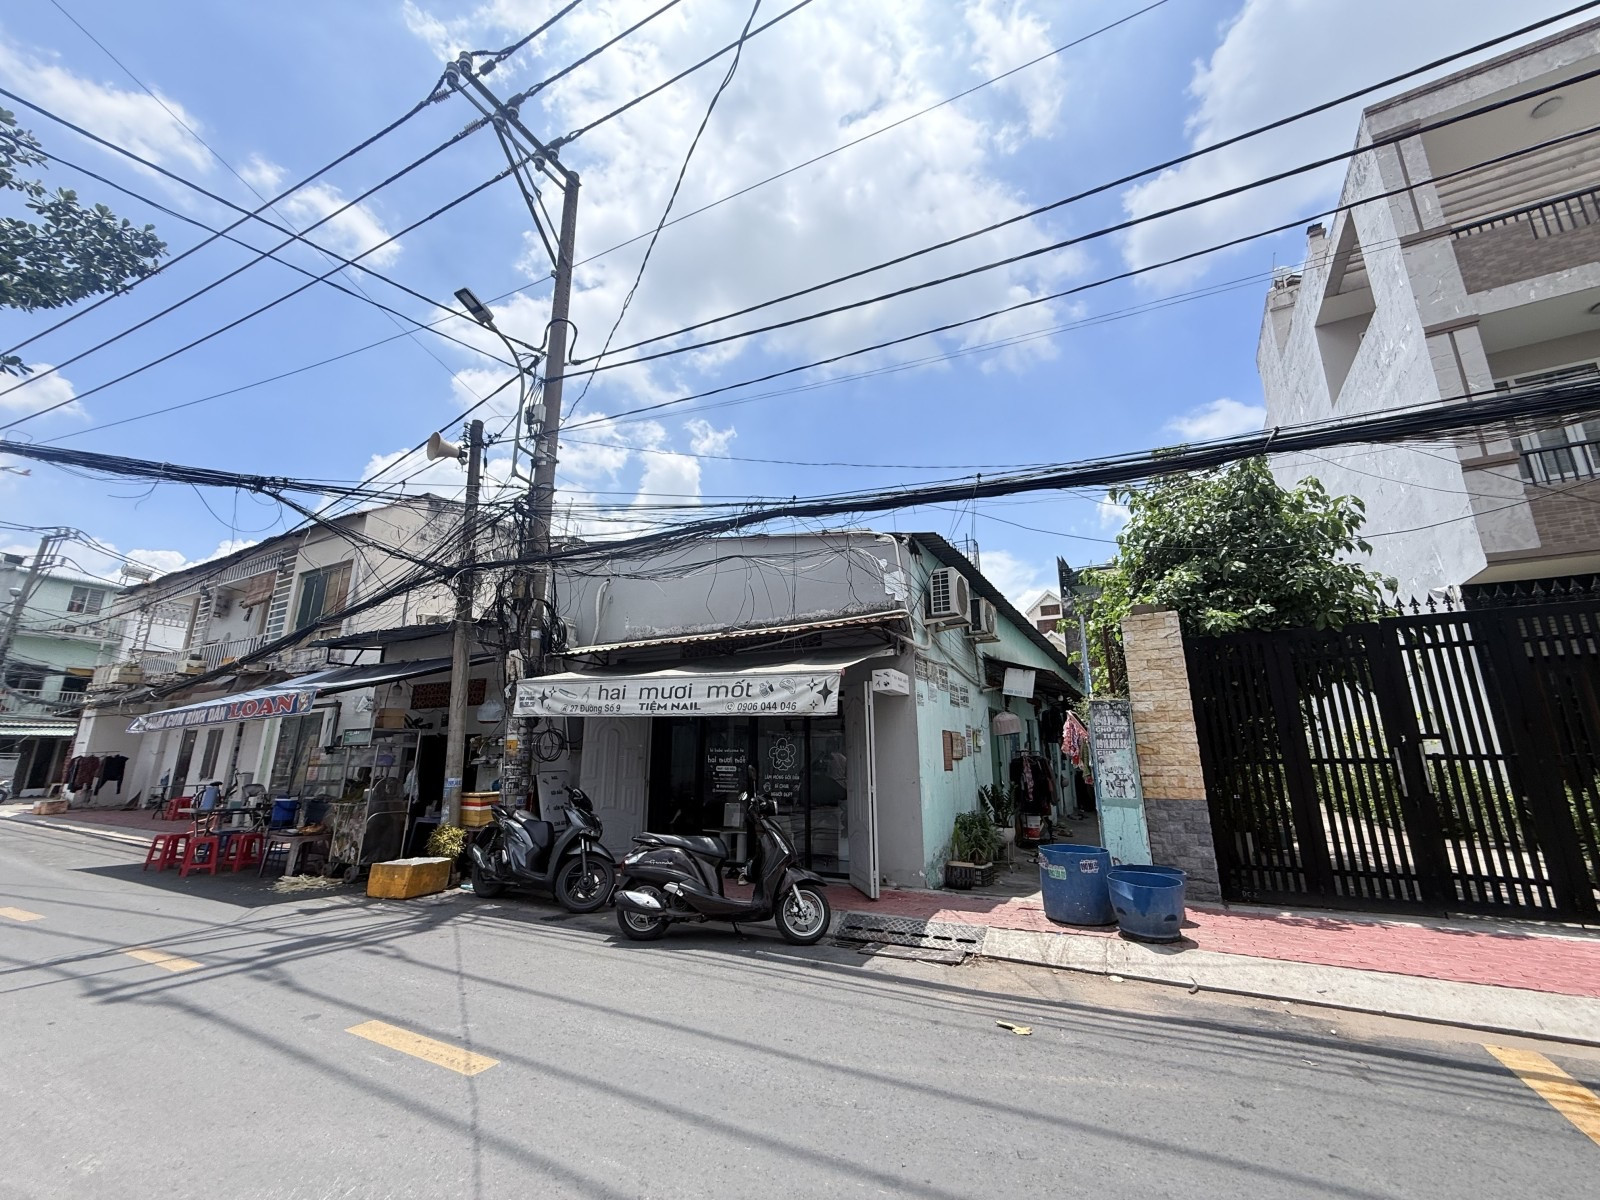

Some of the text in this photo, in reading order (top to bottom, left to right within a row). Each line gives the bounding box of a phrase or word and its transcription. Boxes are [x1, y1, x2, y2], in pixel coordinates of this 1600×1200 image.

[598, 679, 752, 700] hai mươi mốt
[229, 693, 296, 718] LOAN
[580, 703, 601, 715] Đường
[604, 702, 615, 712] Số
[616, 704, 621, 712] 9
[639, 700, 701, 714] TIỆM NAIL
[737, 701, 797, 711] 0906 044 046
